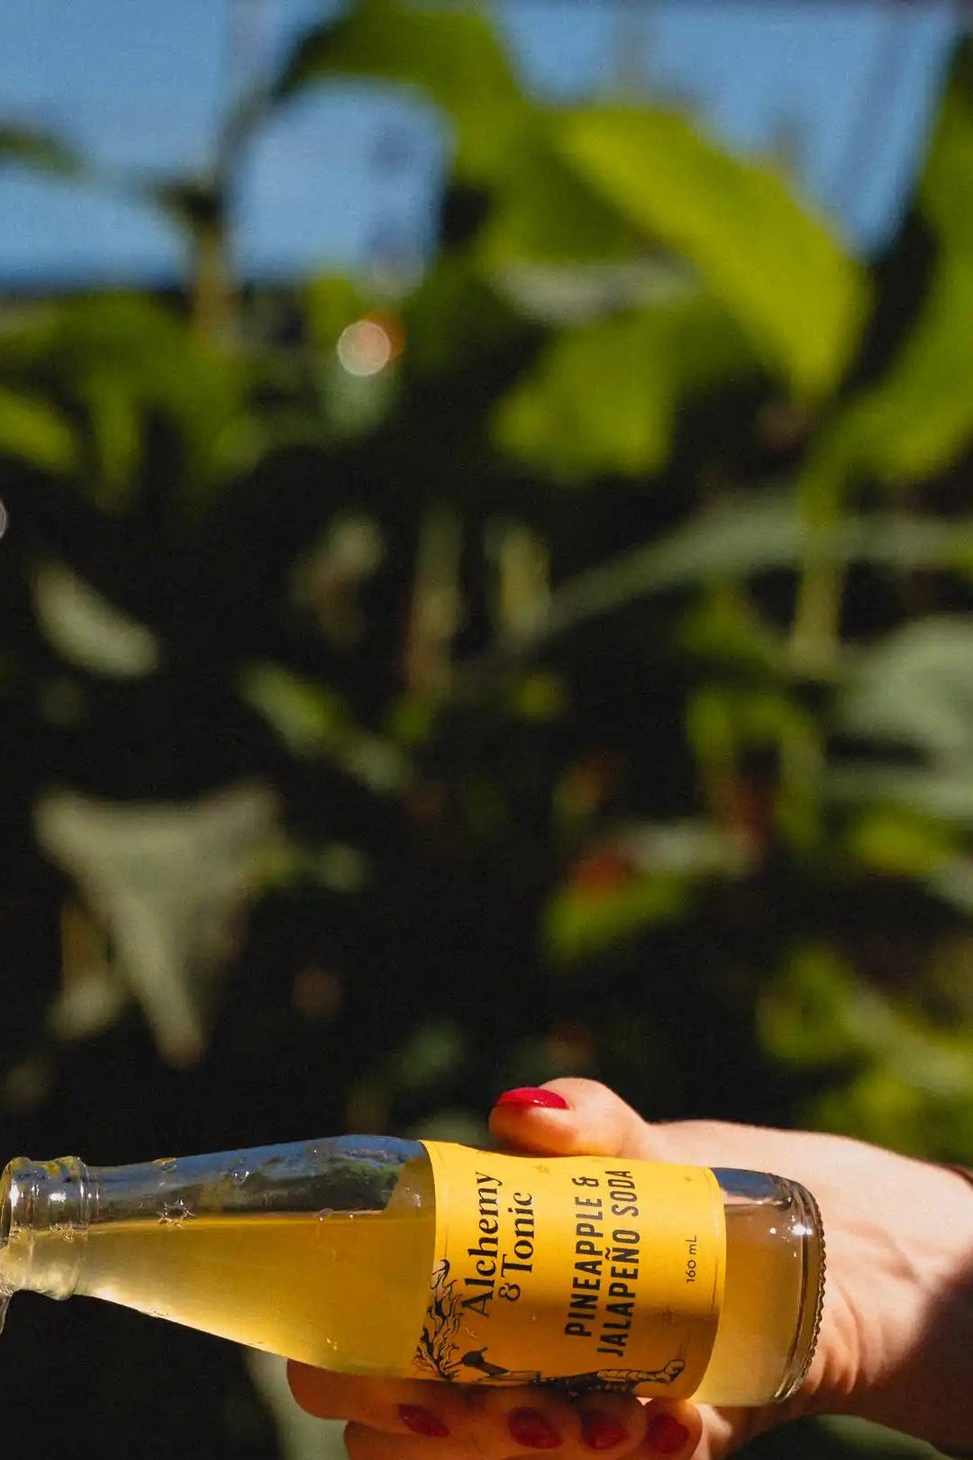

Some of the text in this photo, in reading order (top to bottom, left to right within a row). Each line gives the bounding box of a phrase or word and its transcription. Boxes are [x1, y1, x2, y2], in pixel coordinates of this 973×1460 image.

[461, 1171, 503, 1318] Alchemy
[498, 1192, 534, 1301] & Tonic
[564, 1176, 604, 1337] PINEAPPLE &
[597, 1170, 641, 1358] JALAPEÑO SODA
[686, 1235, 697, 1283] 160 mL
